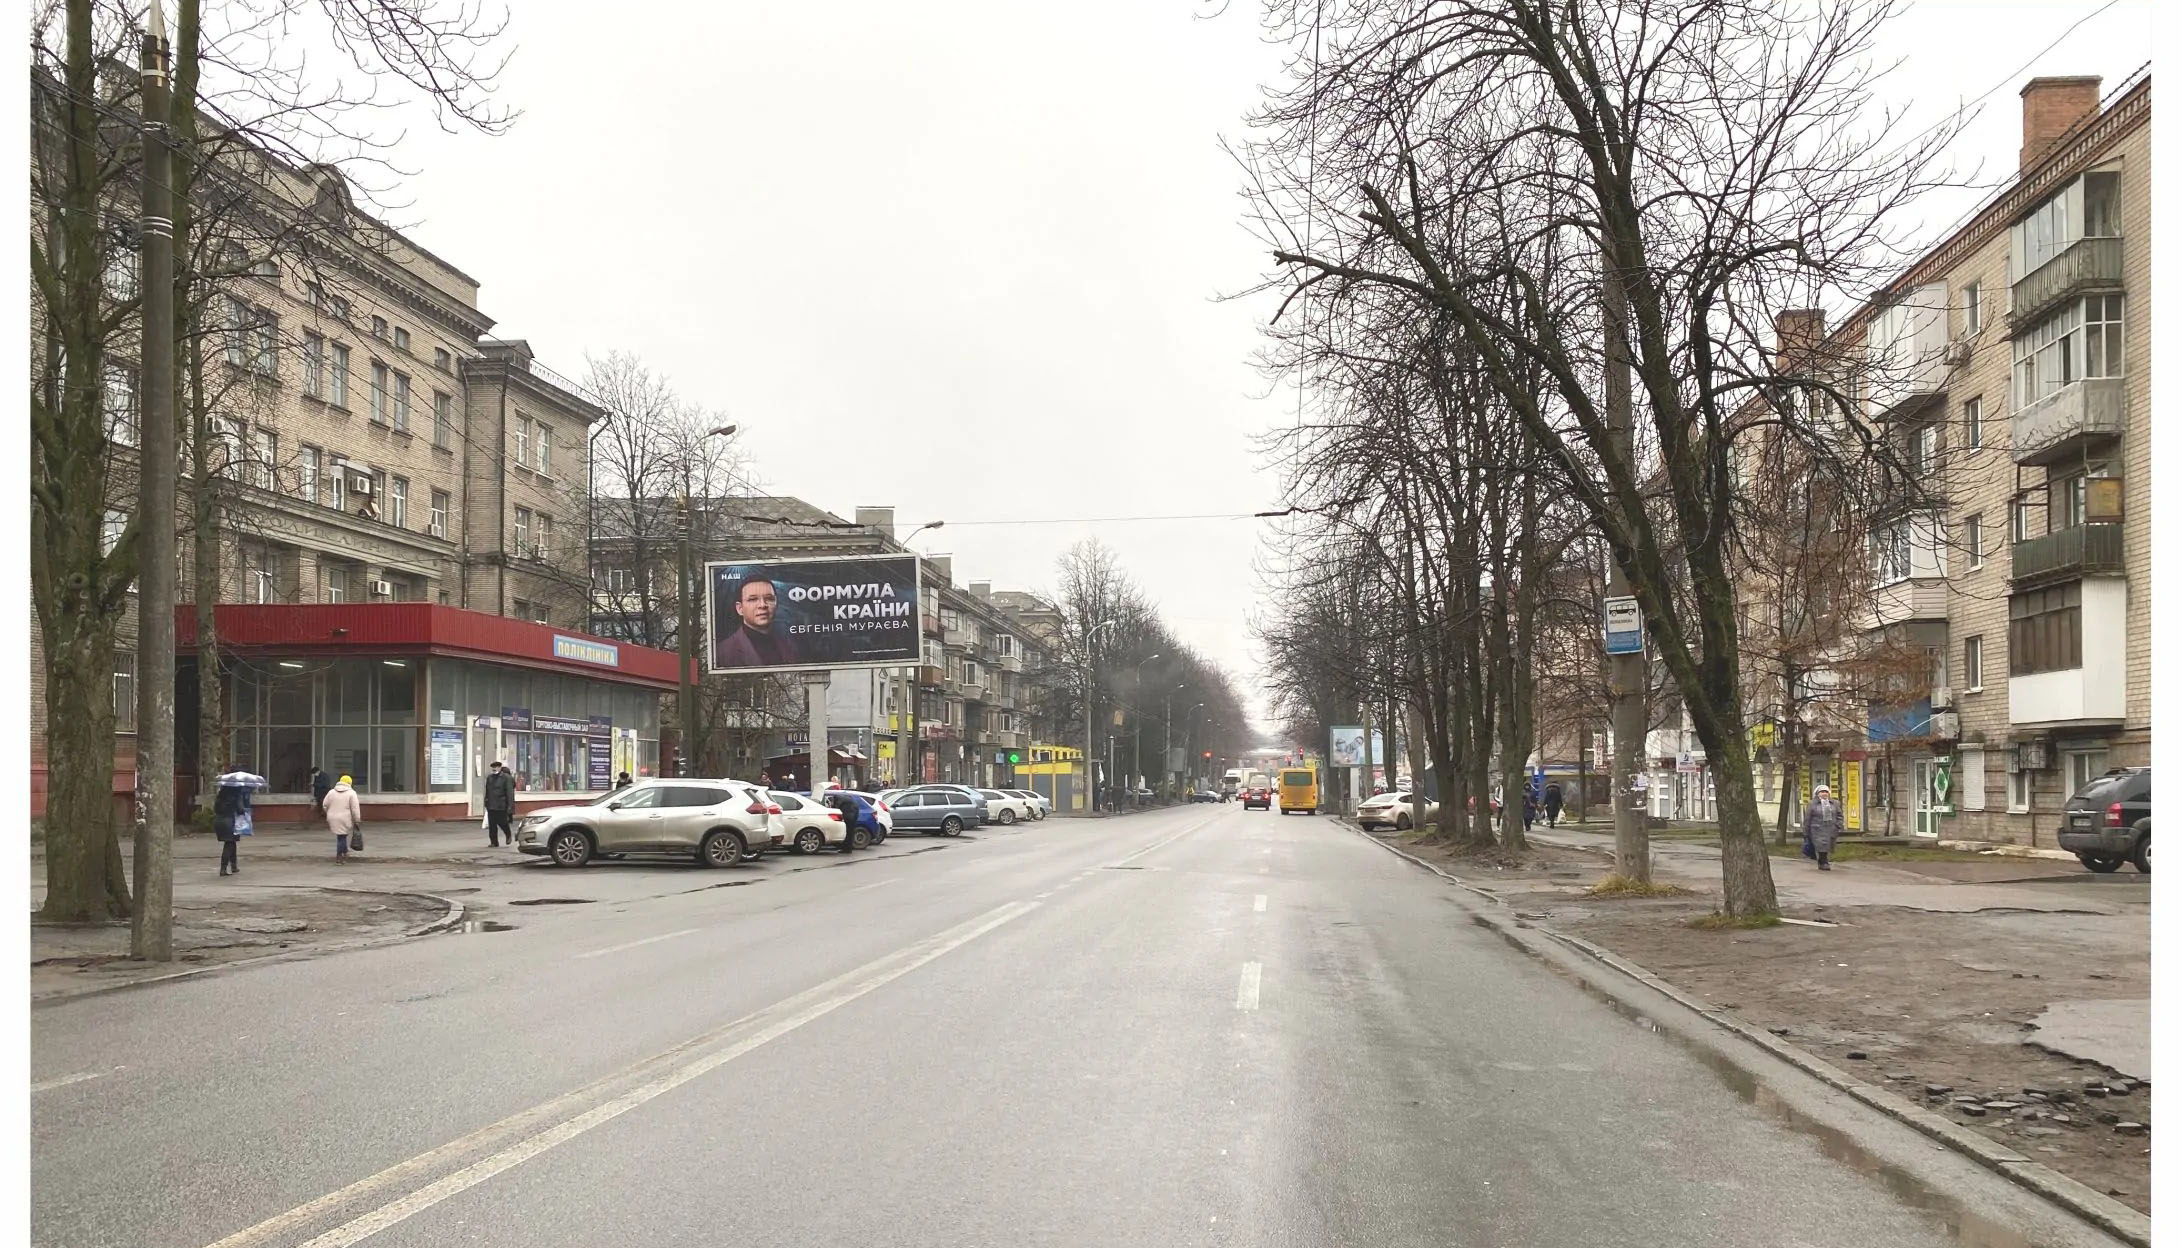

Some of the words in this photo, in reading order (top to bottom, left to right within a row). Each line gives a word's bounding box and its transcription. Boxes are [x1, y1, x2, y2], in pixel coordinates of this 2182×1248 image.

[788, 583, 895, 602] ФОРМУЛА
[833, 600, 910, 620] КРАЇНИ
[789, 623, 843, 634] ЄВГЕНІЯ
[849, 620, 909, 631] МУРАЄВА
[558, 641, 615, 664] ПОЛІКЛІНІКА
